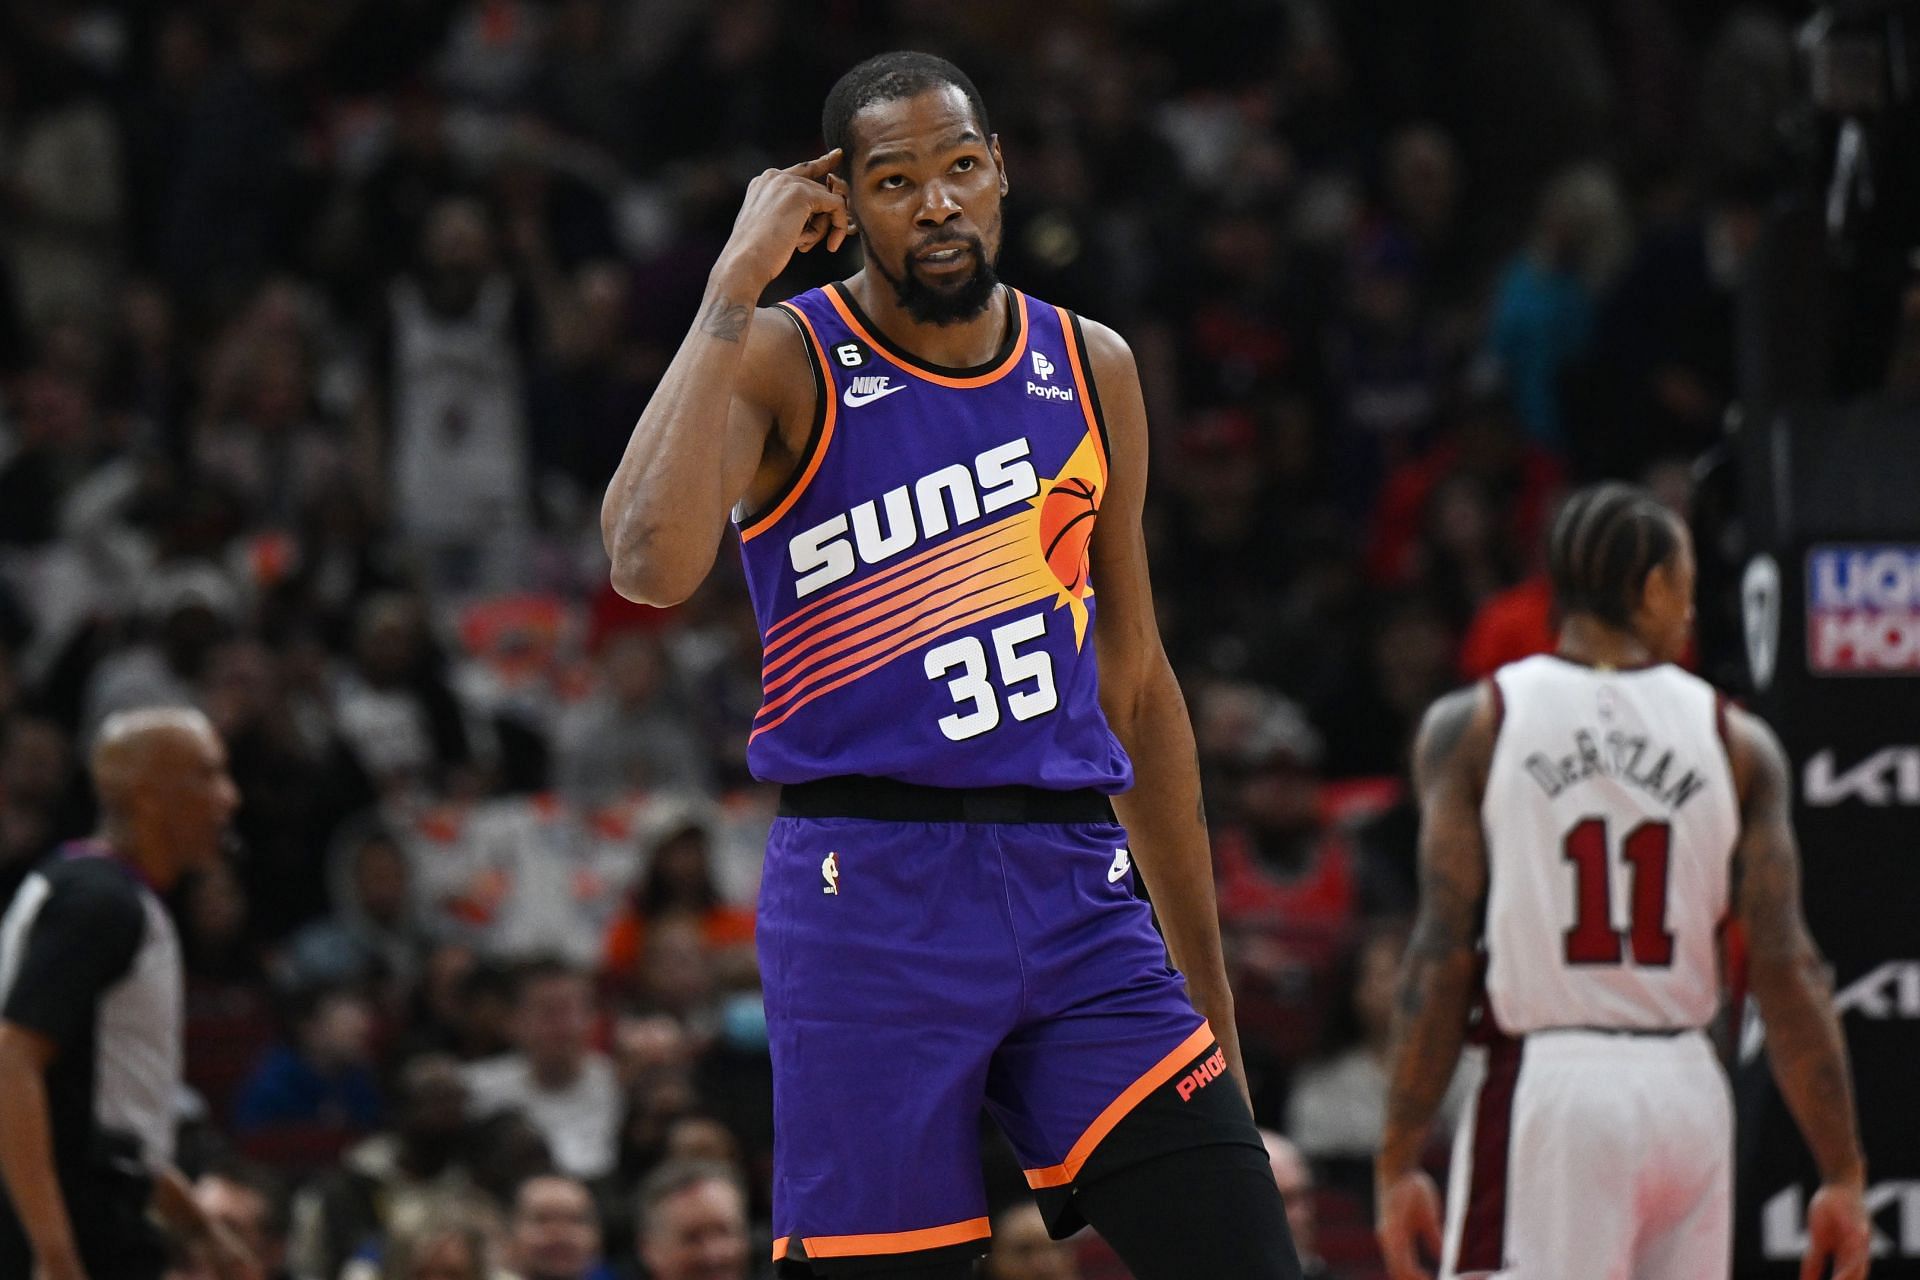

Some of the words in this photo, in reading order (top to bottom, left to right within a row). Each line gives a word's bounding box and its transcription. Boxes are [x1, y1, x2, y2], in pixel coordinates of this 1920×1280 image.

[837, 344, 863, 367] 6
[851, 376, 890, 394] NIKE
[1027, 381, 1073, 401] PayPal
[923, 612, 1059, 741] 35
[1562, 815, 1675, 968] 11
